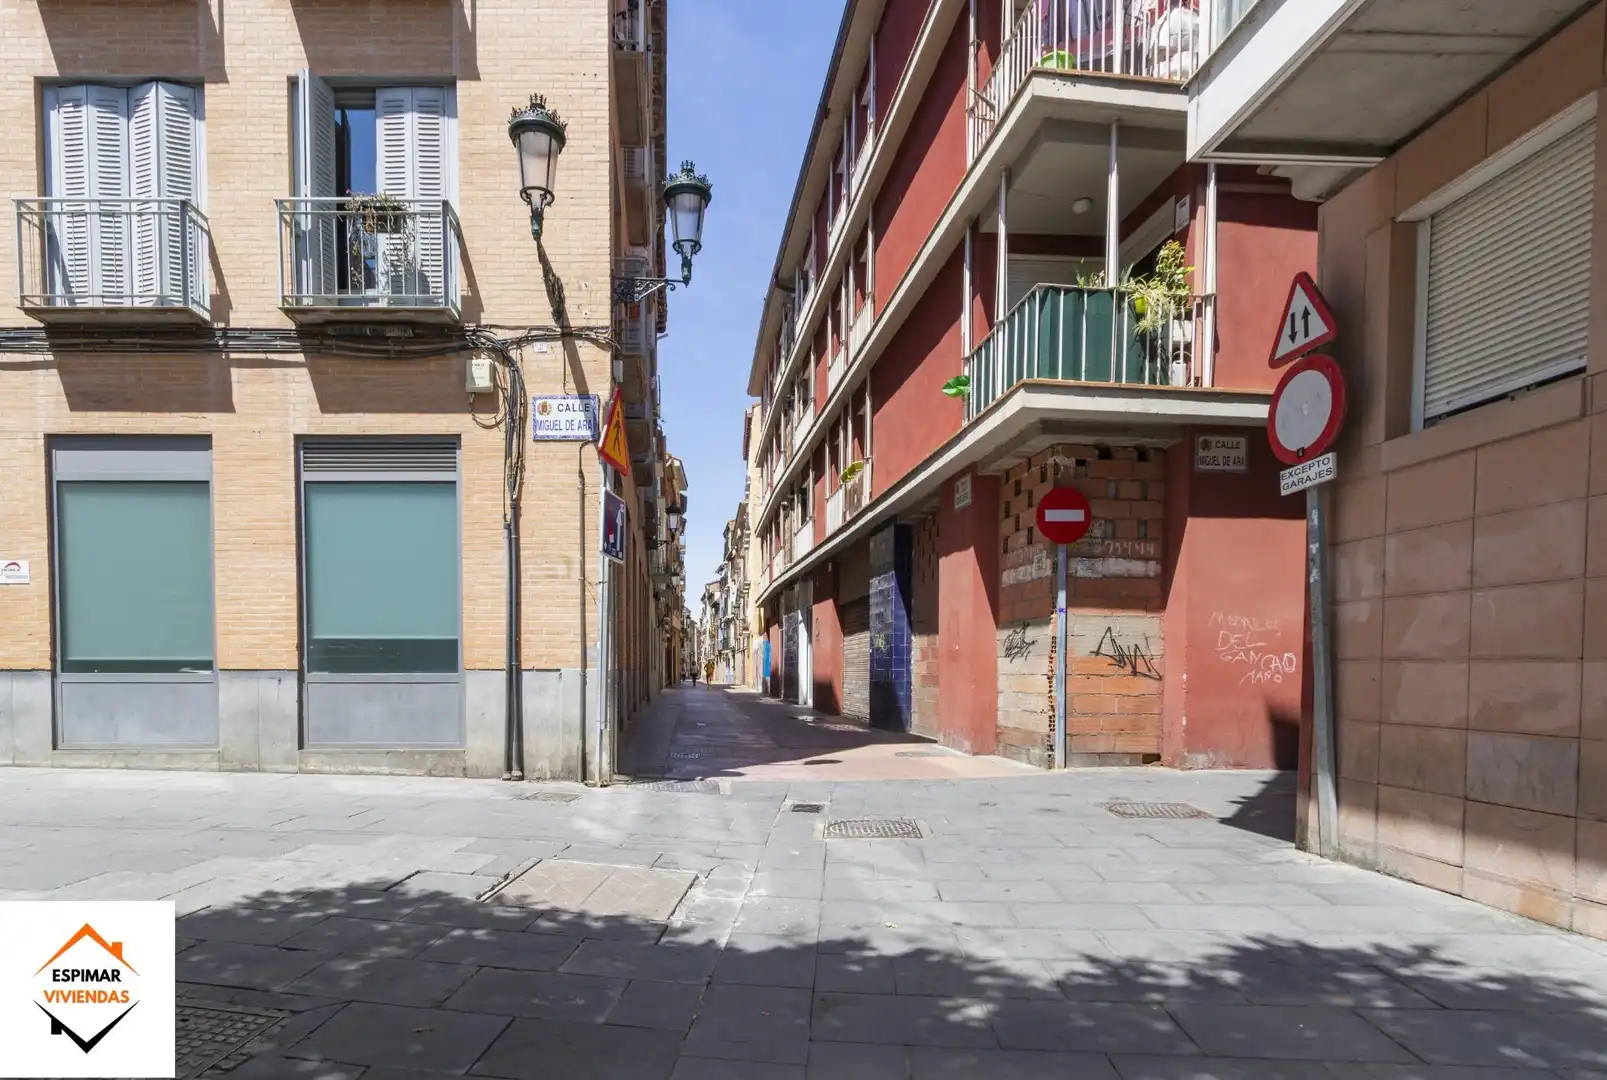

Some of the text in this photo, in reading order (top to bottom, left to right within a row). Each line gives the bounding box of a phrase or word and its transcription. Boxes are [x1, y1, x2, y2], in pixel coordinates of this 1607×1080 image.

[556, 403, 590, 412] CALLE
[535, 419, 593, 432] MIGUEL DE ARA
[1215, 440, 1241, 449] CALLE
[1199, 455, 1221, 466] MIGUEL
[1222, 455, 1231, 466] DE
[1281, 457, 1331, 481] EXCEPTO
[1282, 467, 1333, 491] GARAJES
[1212, 630, 1267, 650] DEL
